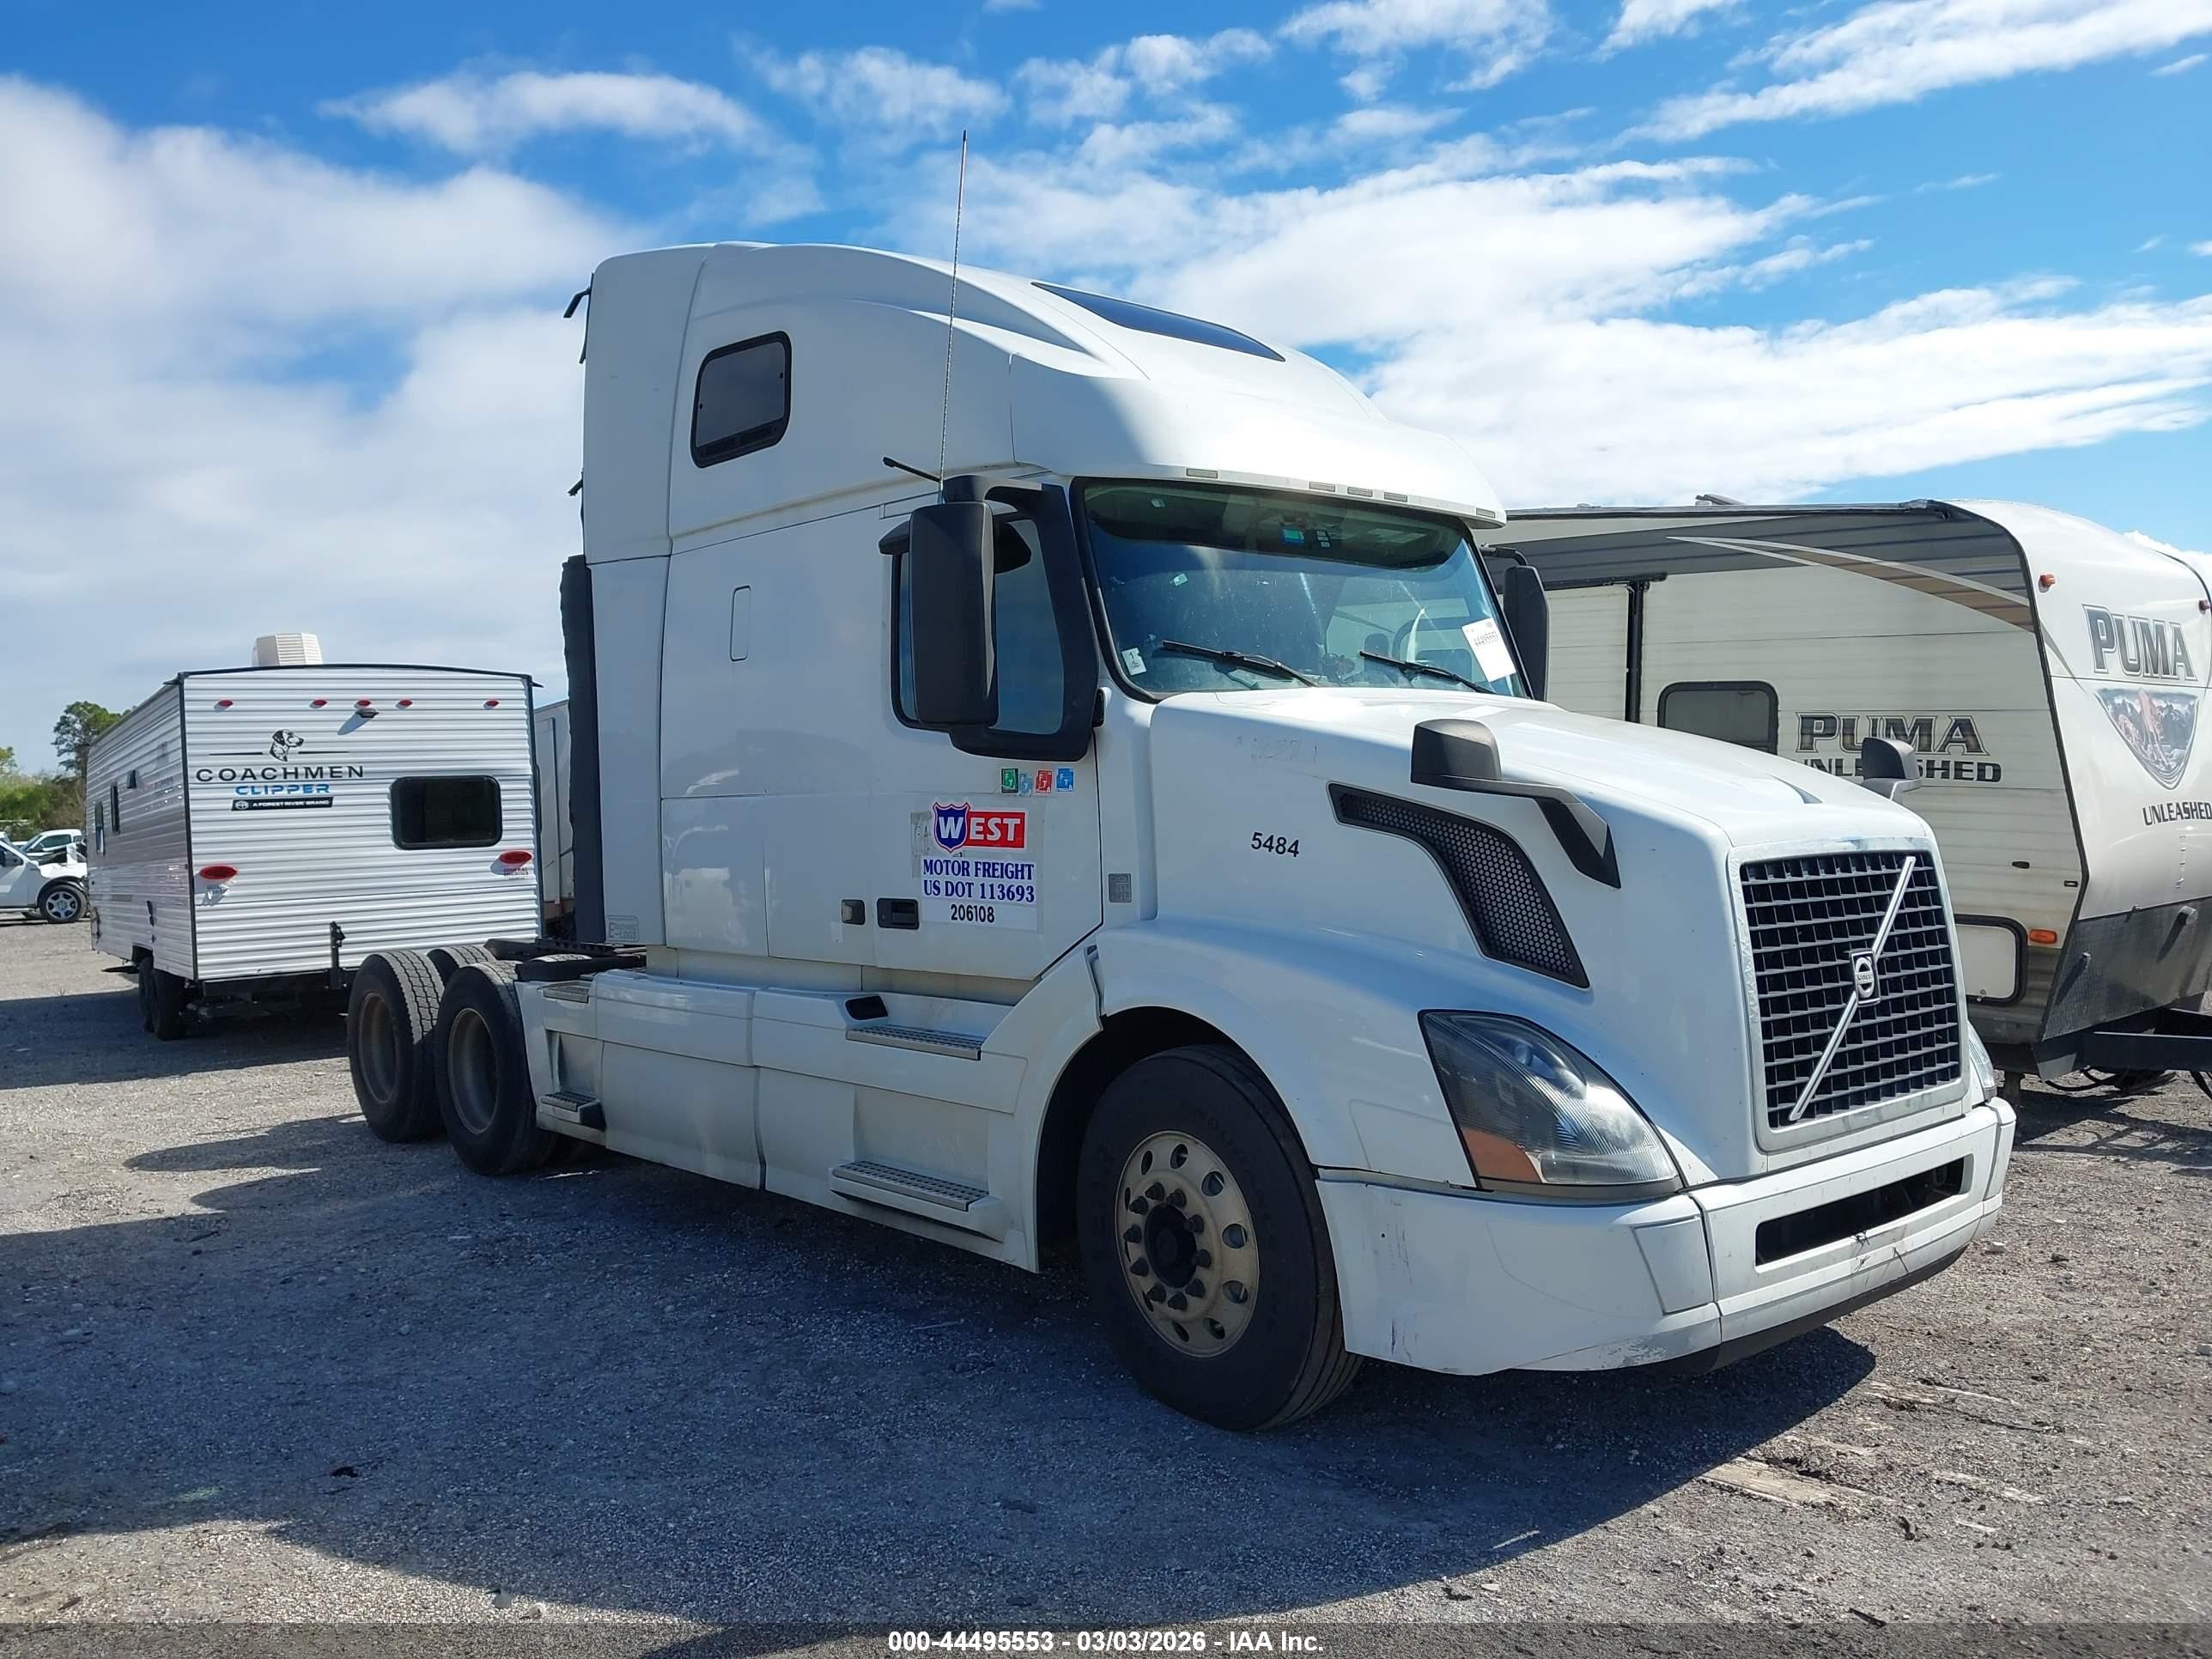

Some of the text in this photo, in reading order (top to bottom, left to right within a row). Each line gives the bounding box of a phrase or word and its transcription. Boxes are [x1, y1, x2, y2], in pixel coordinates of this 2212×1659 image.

[2081, 604, 2198, 681] PUMA
[1796, 712, 1990, 757] PUMA
[196, 765, 364, 782] COACHMEN
[235, 783, 331, 795] CLIPPER
[2142, 801, 2212, 826] UNLEASHED
[939, 817, 1021, 842] WEST
[1250, 831, 1300, 858] 5484
[923, 859, 1035, 881] MOTOR FREIGHT
[923, 879, 1035, 902] US DOT 113693
[951, 904, 995, 923] 206108
